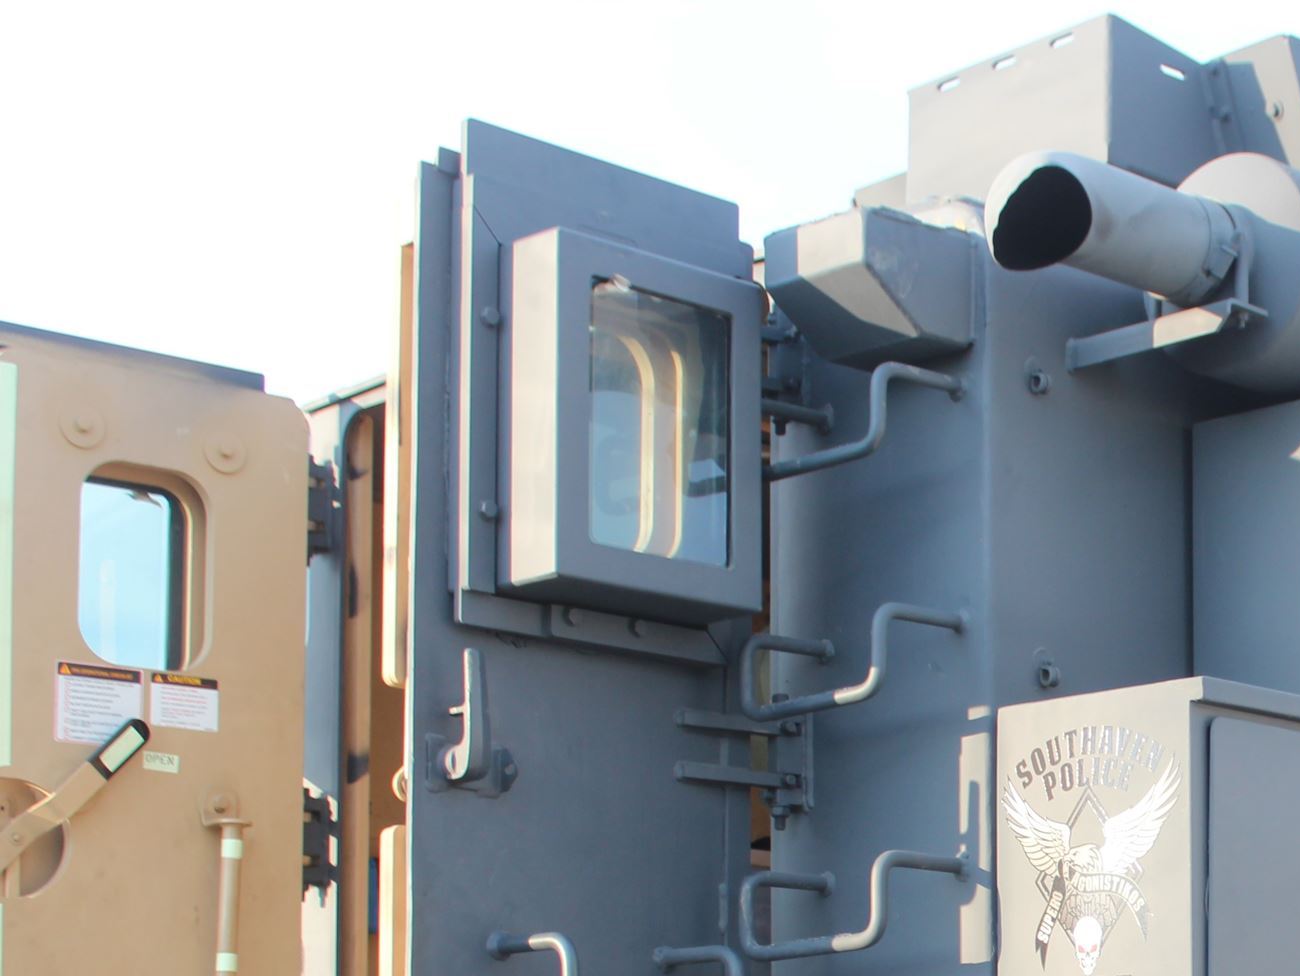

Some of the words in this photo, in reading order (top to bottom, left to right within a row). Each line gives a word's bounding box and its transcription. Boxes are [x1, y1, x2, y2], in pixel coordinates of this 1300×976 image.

[145, 754, 176, 767] OPEN
[1015, 725, 1166, 790] SOUTHAVEN
[1043, 756, 1136, 801] POLICE
[1037, 890, 1064, 945] SUPERO
